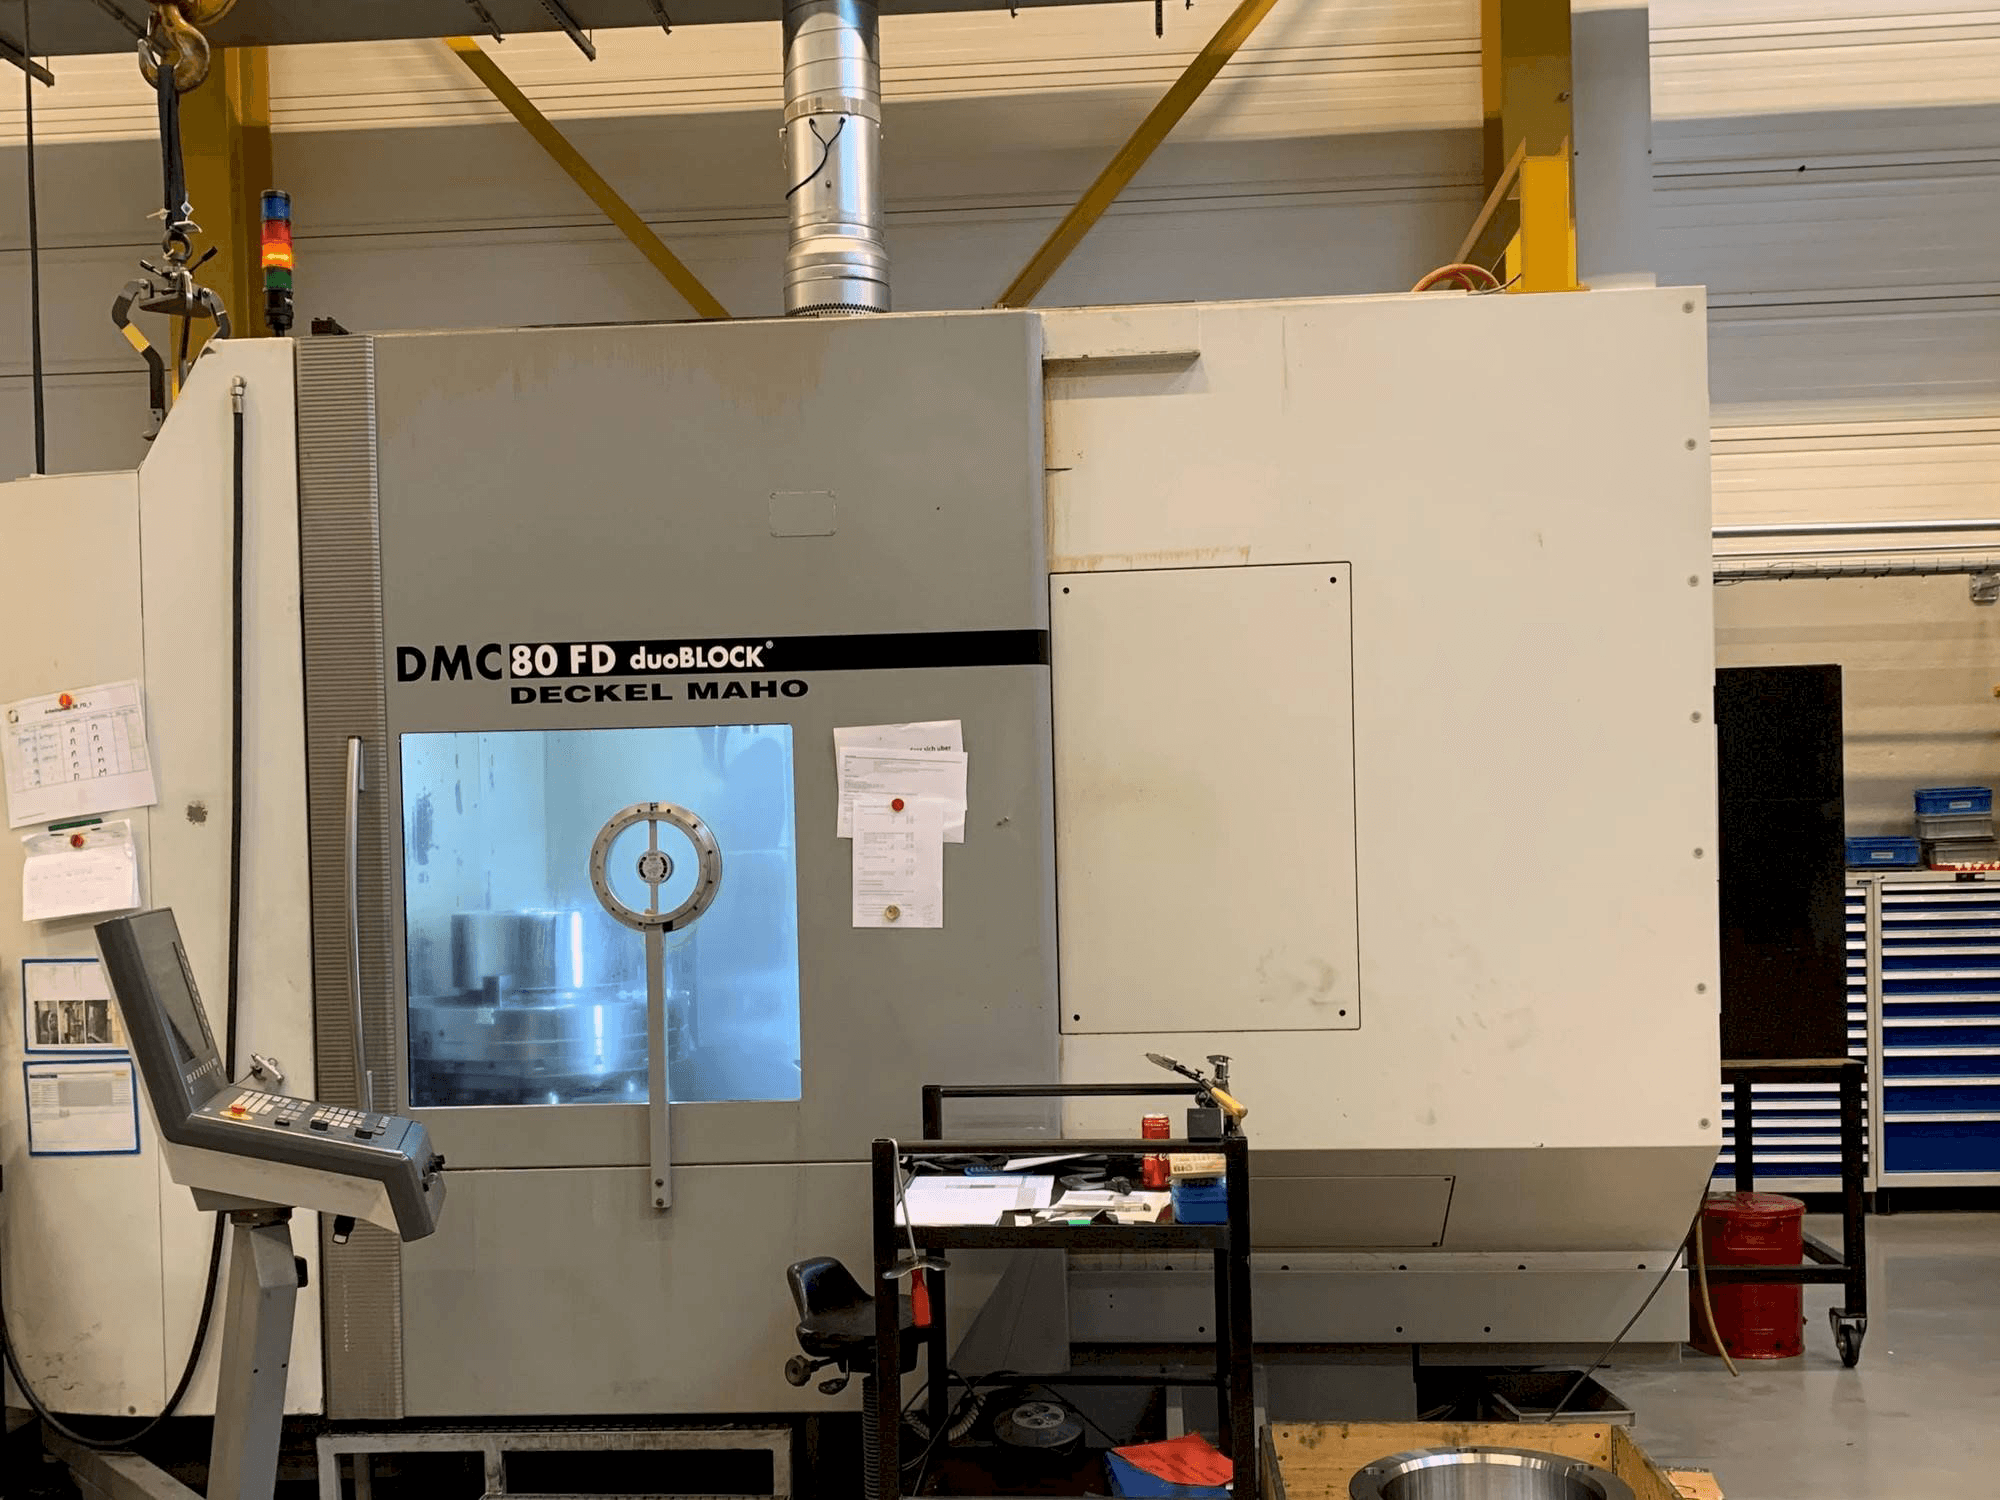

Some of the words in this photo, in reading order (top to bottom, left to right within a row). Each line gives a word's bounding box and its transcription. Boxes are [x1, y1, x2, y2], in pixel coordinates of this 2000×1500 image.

[396, 643, 503, 682] DMC
[511, 644, 559, 676] 80
[570, 643, 617, 675] FD
[510, 683, 673, 705] DECKEL
[687, 679, 809, 700] MAHO
